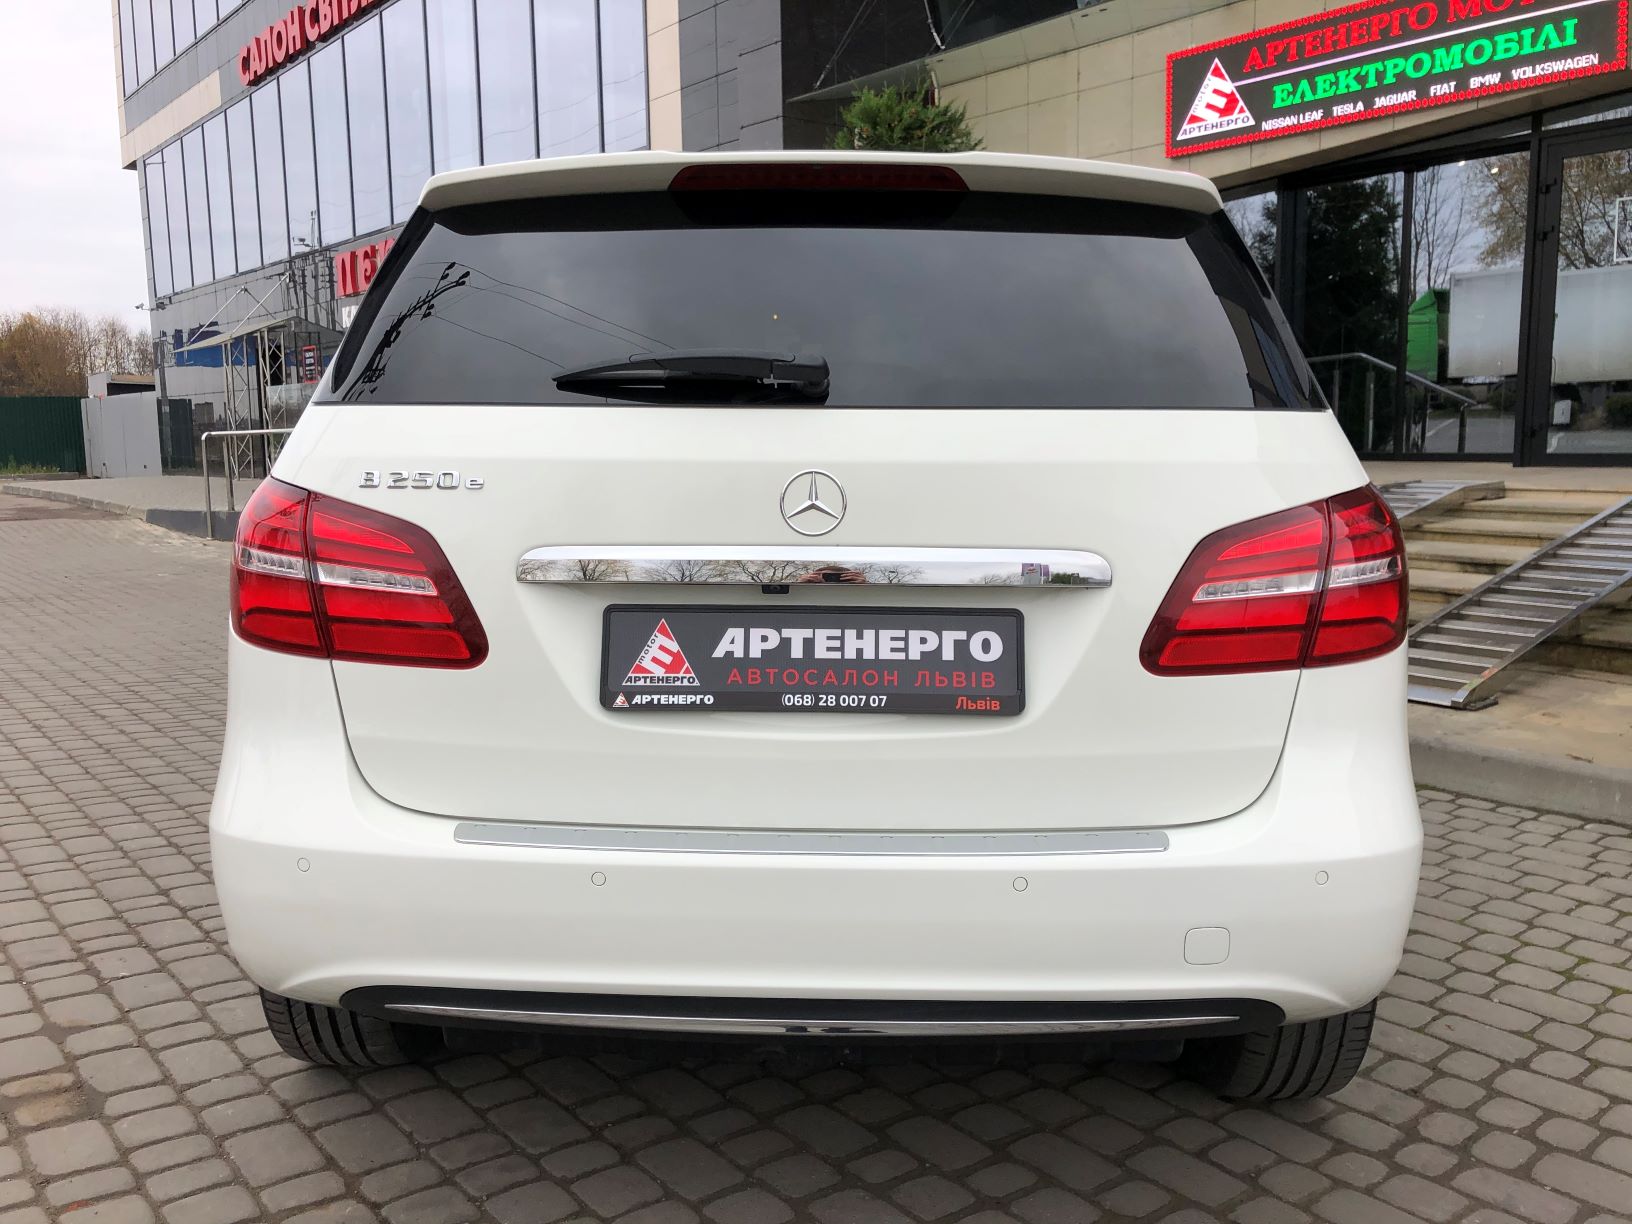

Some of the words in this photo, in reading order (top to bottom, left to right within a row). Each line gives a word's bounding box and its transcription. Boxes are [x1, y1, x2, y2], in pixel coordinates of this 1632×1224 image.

[239, 7, 304, 86] САЛОН
[1243, 2, 1438, 73] АРТЕНЕРГО
[1272, 18, 1578, 109] ЕЛЕКТРОМОБІЛІ
[1261, 114, 1299, 132] NISSAN
[1299, 109, 1325, 124] LEAF
[1332, 100, 1365, 117] TESLA
[1373, 89, 1418, 109] JAGUAR
[1430, 81, 1457, 97] FIAT
[1469, 72, 1502, 90] BMW
[1511, 52, 1600, 81] VOLKSWAGEN
[1181, 115, 1251, 137] АРТЕНЕРГО
[359, 470, 381, 489] B
[637, 633, 659, 665] motor
[711, 627, 1004, 662] АРТЕНЕРГО
[727, 667, 899, 687] АВТОСАЛОН
[915, 669, 997, 689] ЛЬВІВ
[631, 694, 715, 706] АРТЕНЕРГО
[781, 693, 815, 707] (068)
[818, 695, 837, 707] 28
[839, 695, 867, 707] 007
[869, 695, 888, 707] 07
[955, 697, 1001, 711] Львів
